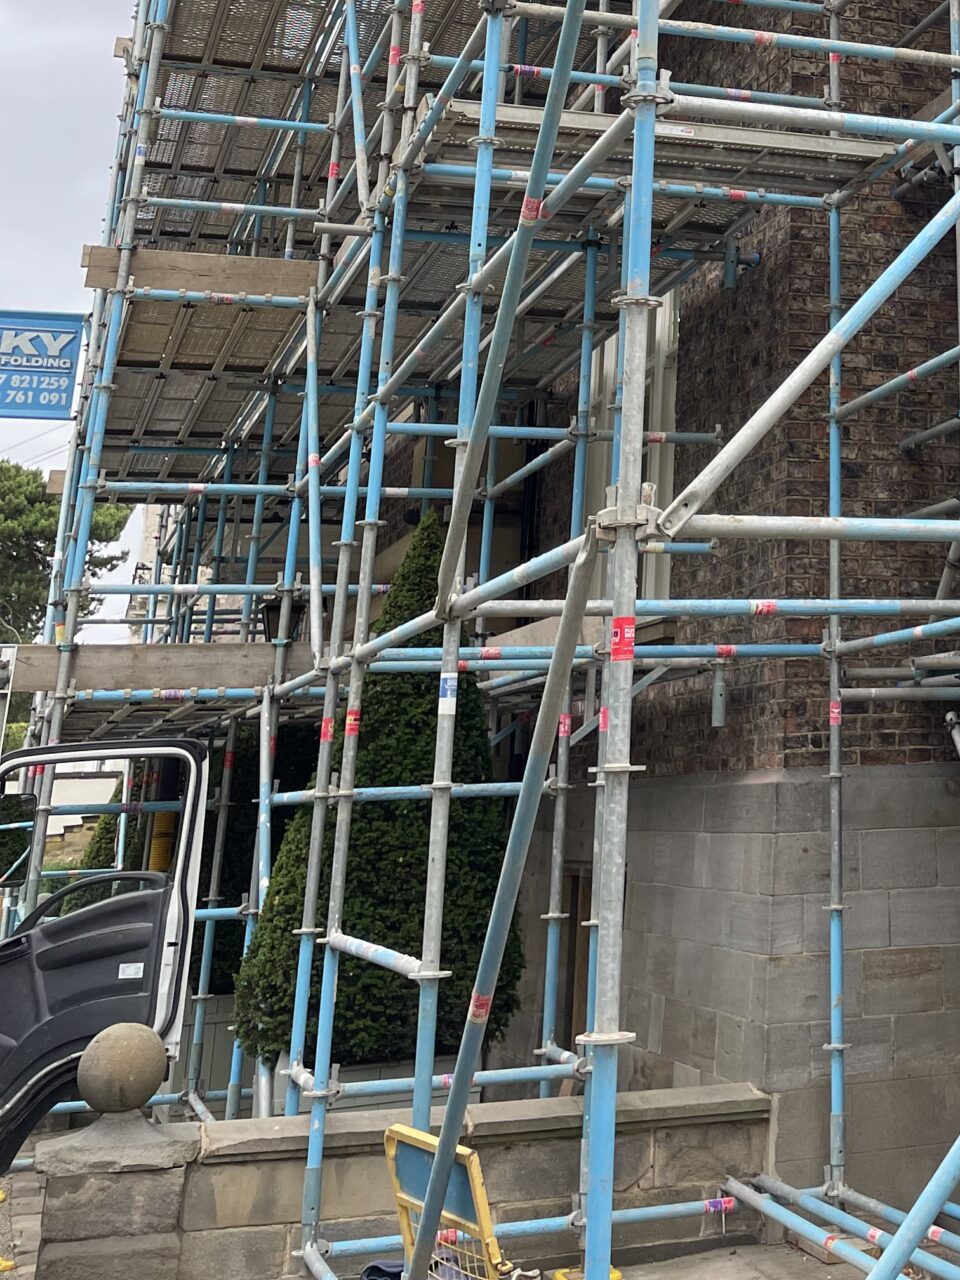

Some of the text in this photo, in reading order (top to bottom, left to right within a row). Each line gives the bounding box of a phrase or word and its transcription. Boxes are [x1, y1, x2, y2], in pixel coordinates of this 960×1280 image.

[0, 330, 76, 357] KY
[0, 355, 71, 368] FOLDING
[10, 375, 69, 389] 821259
[5, 390, 67, 405] 761 091
